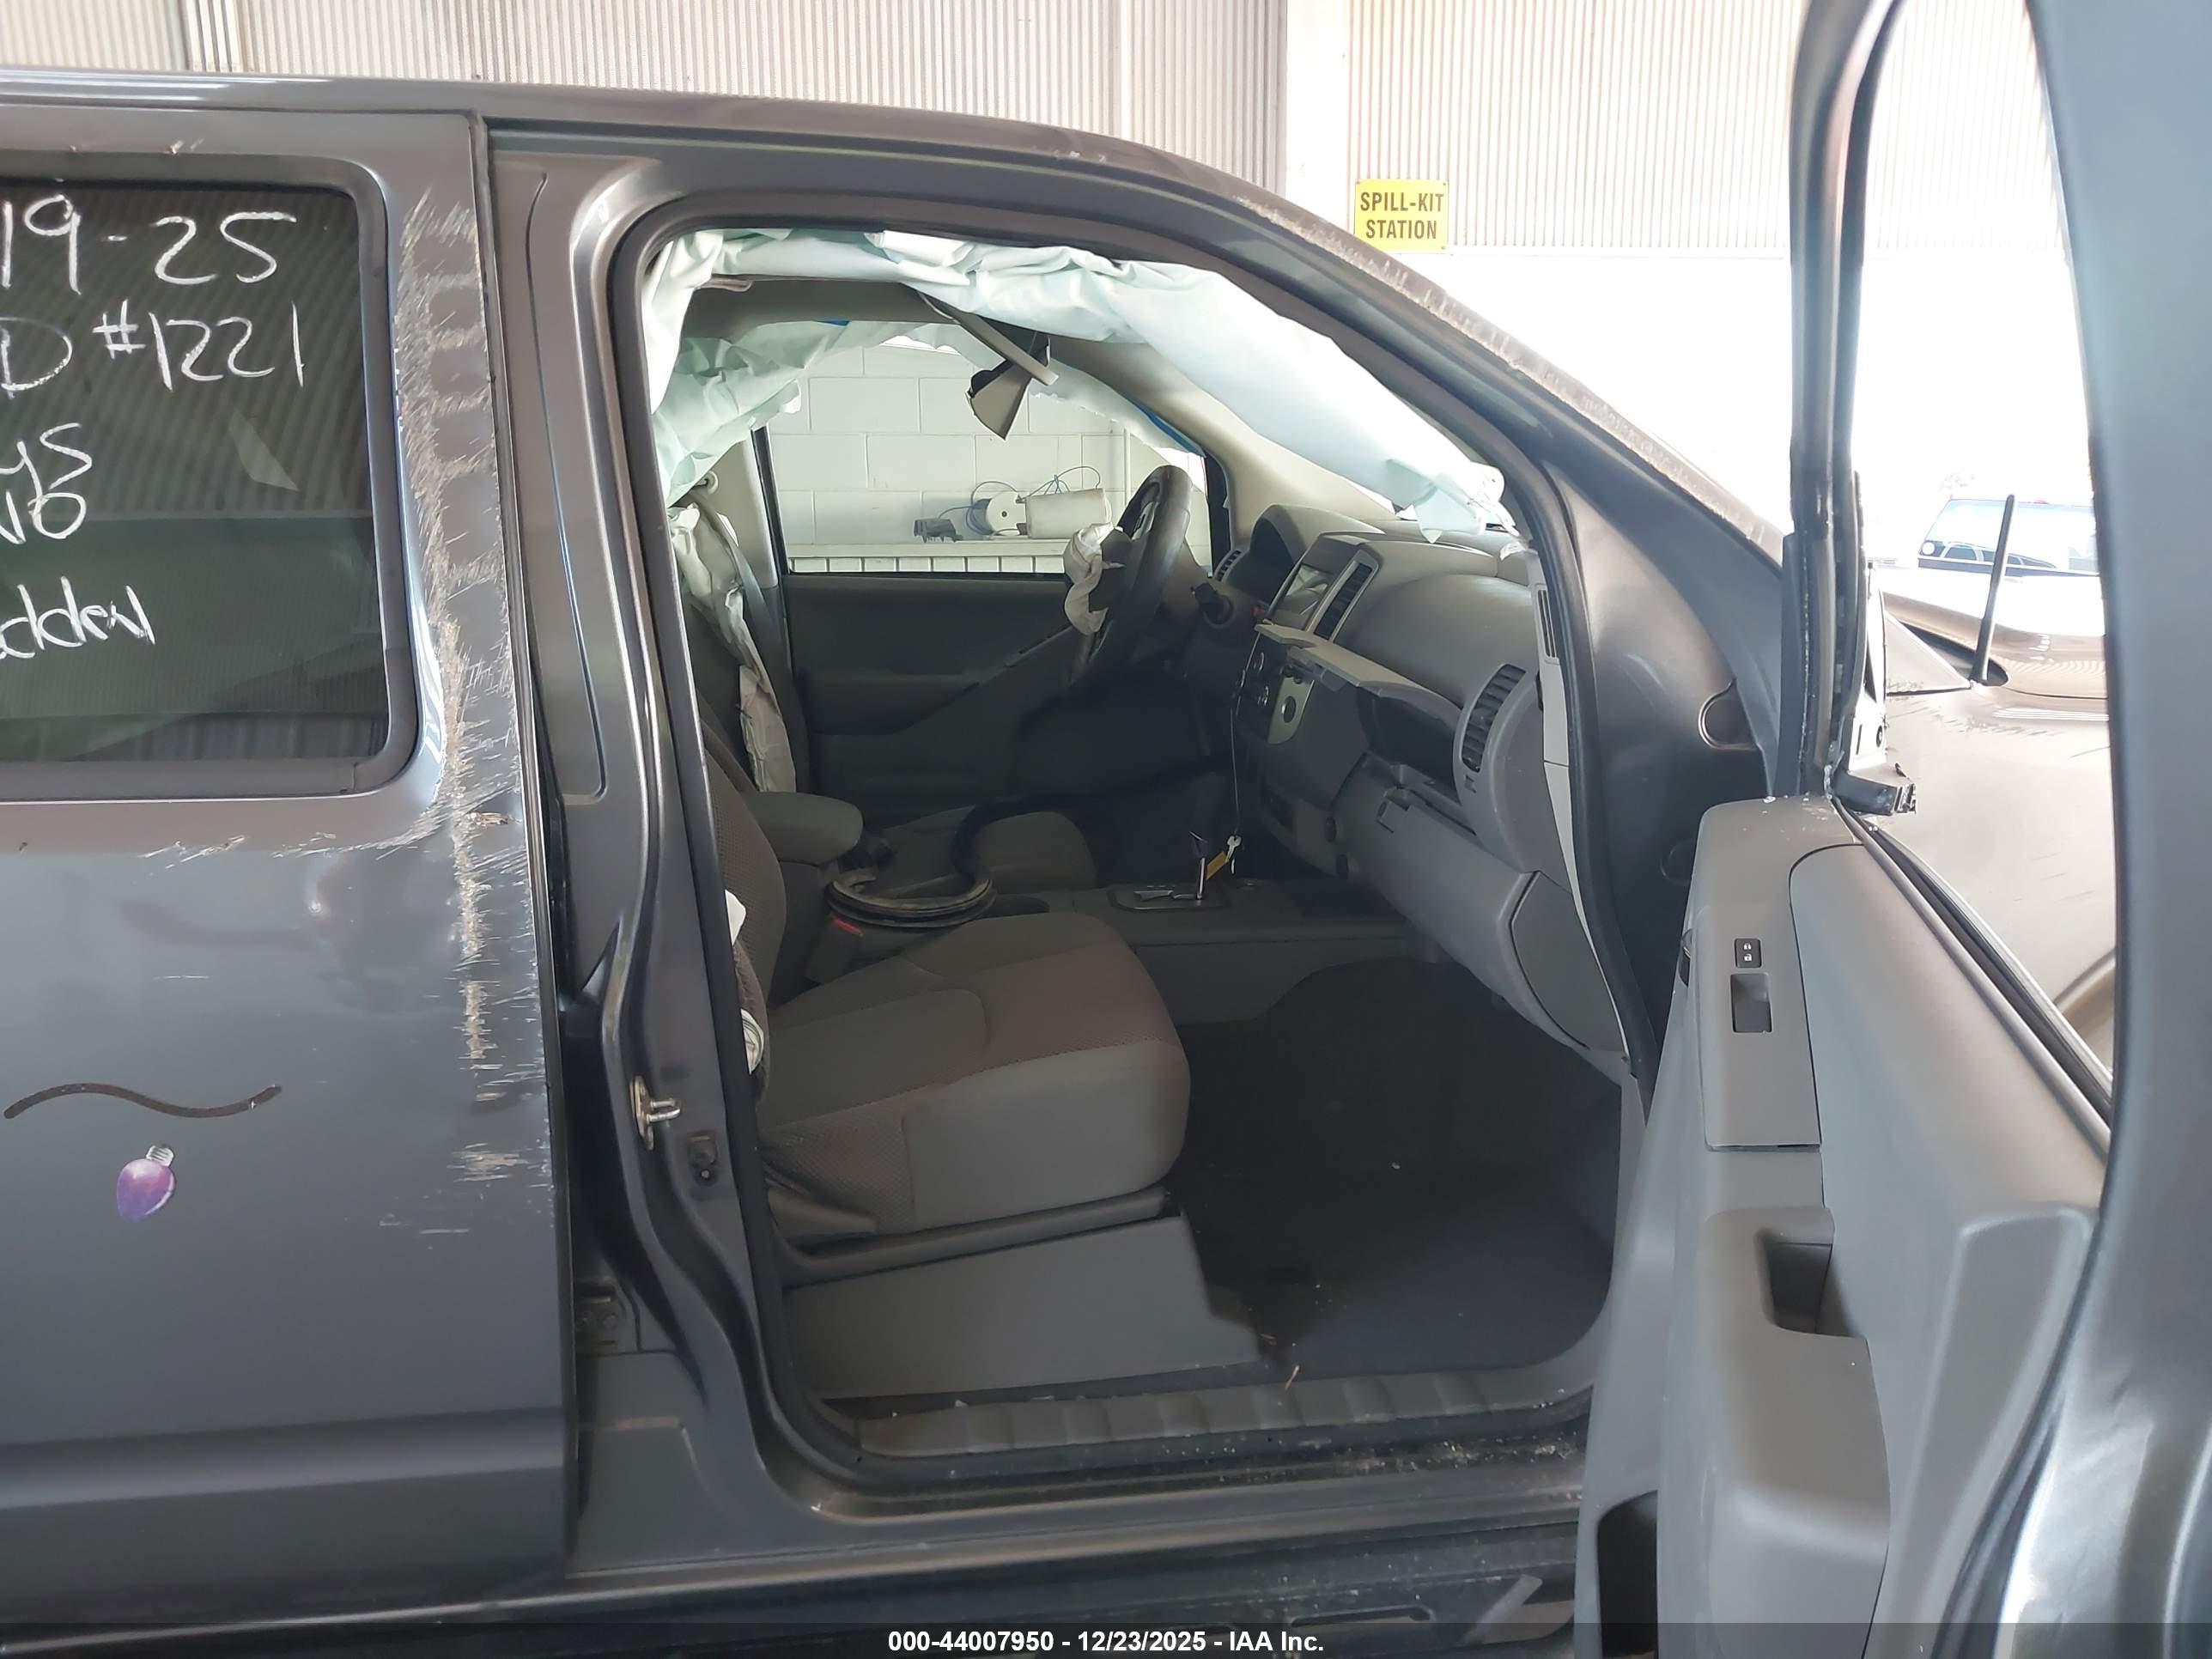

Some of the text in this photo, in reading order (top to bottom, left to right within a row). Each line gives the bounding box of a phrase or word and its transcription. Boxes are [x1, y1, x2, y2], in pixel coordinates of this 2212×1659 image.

[1360, 191, 1444, 212] SPILL-KIT
[1365, 219, 1437, 240] STATION
[93, 299, 305, 392] #1221
